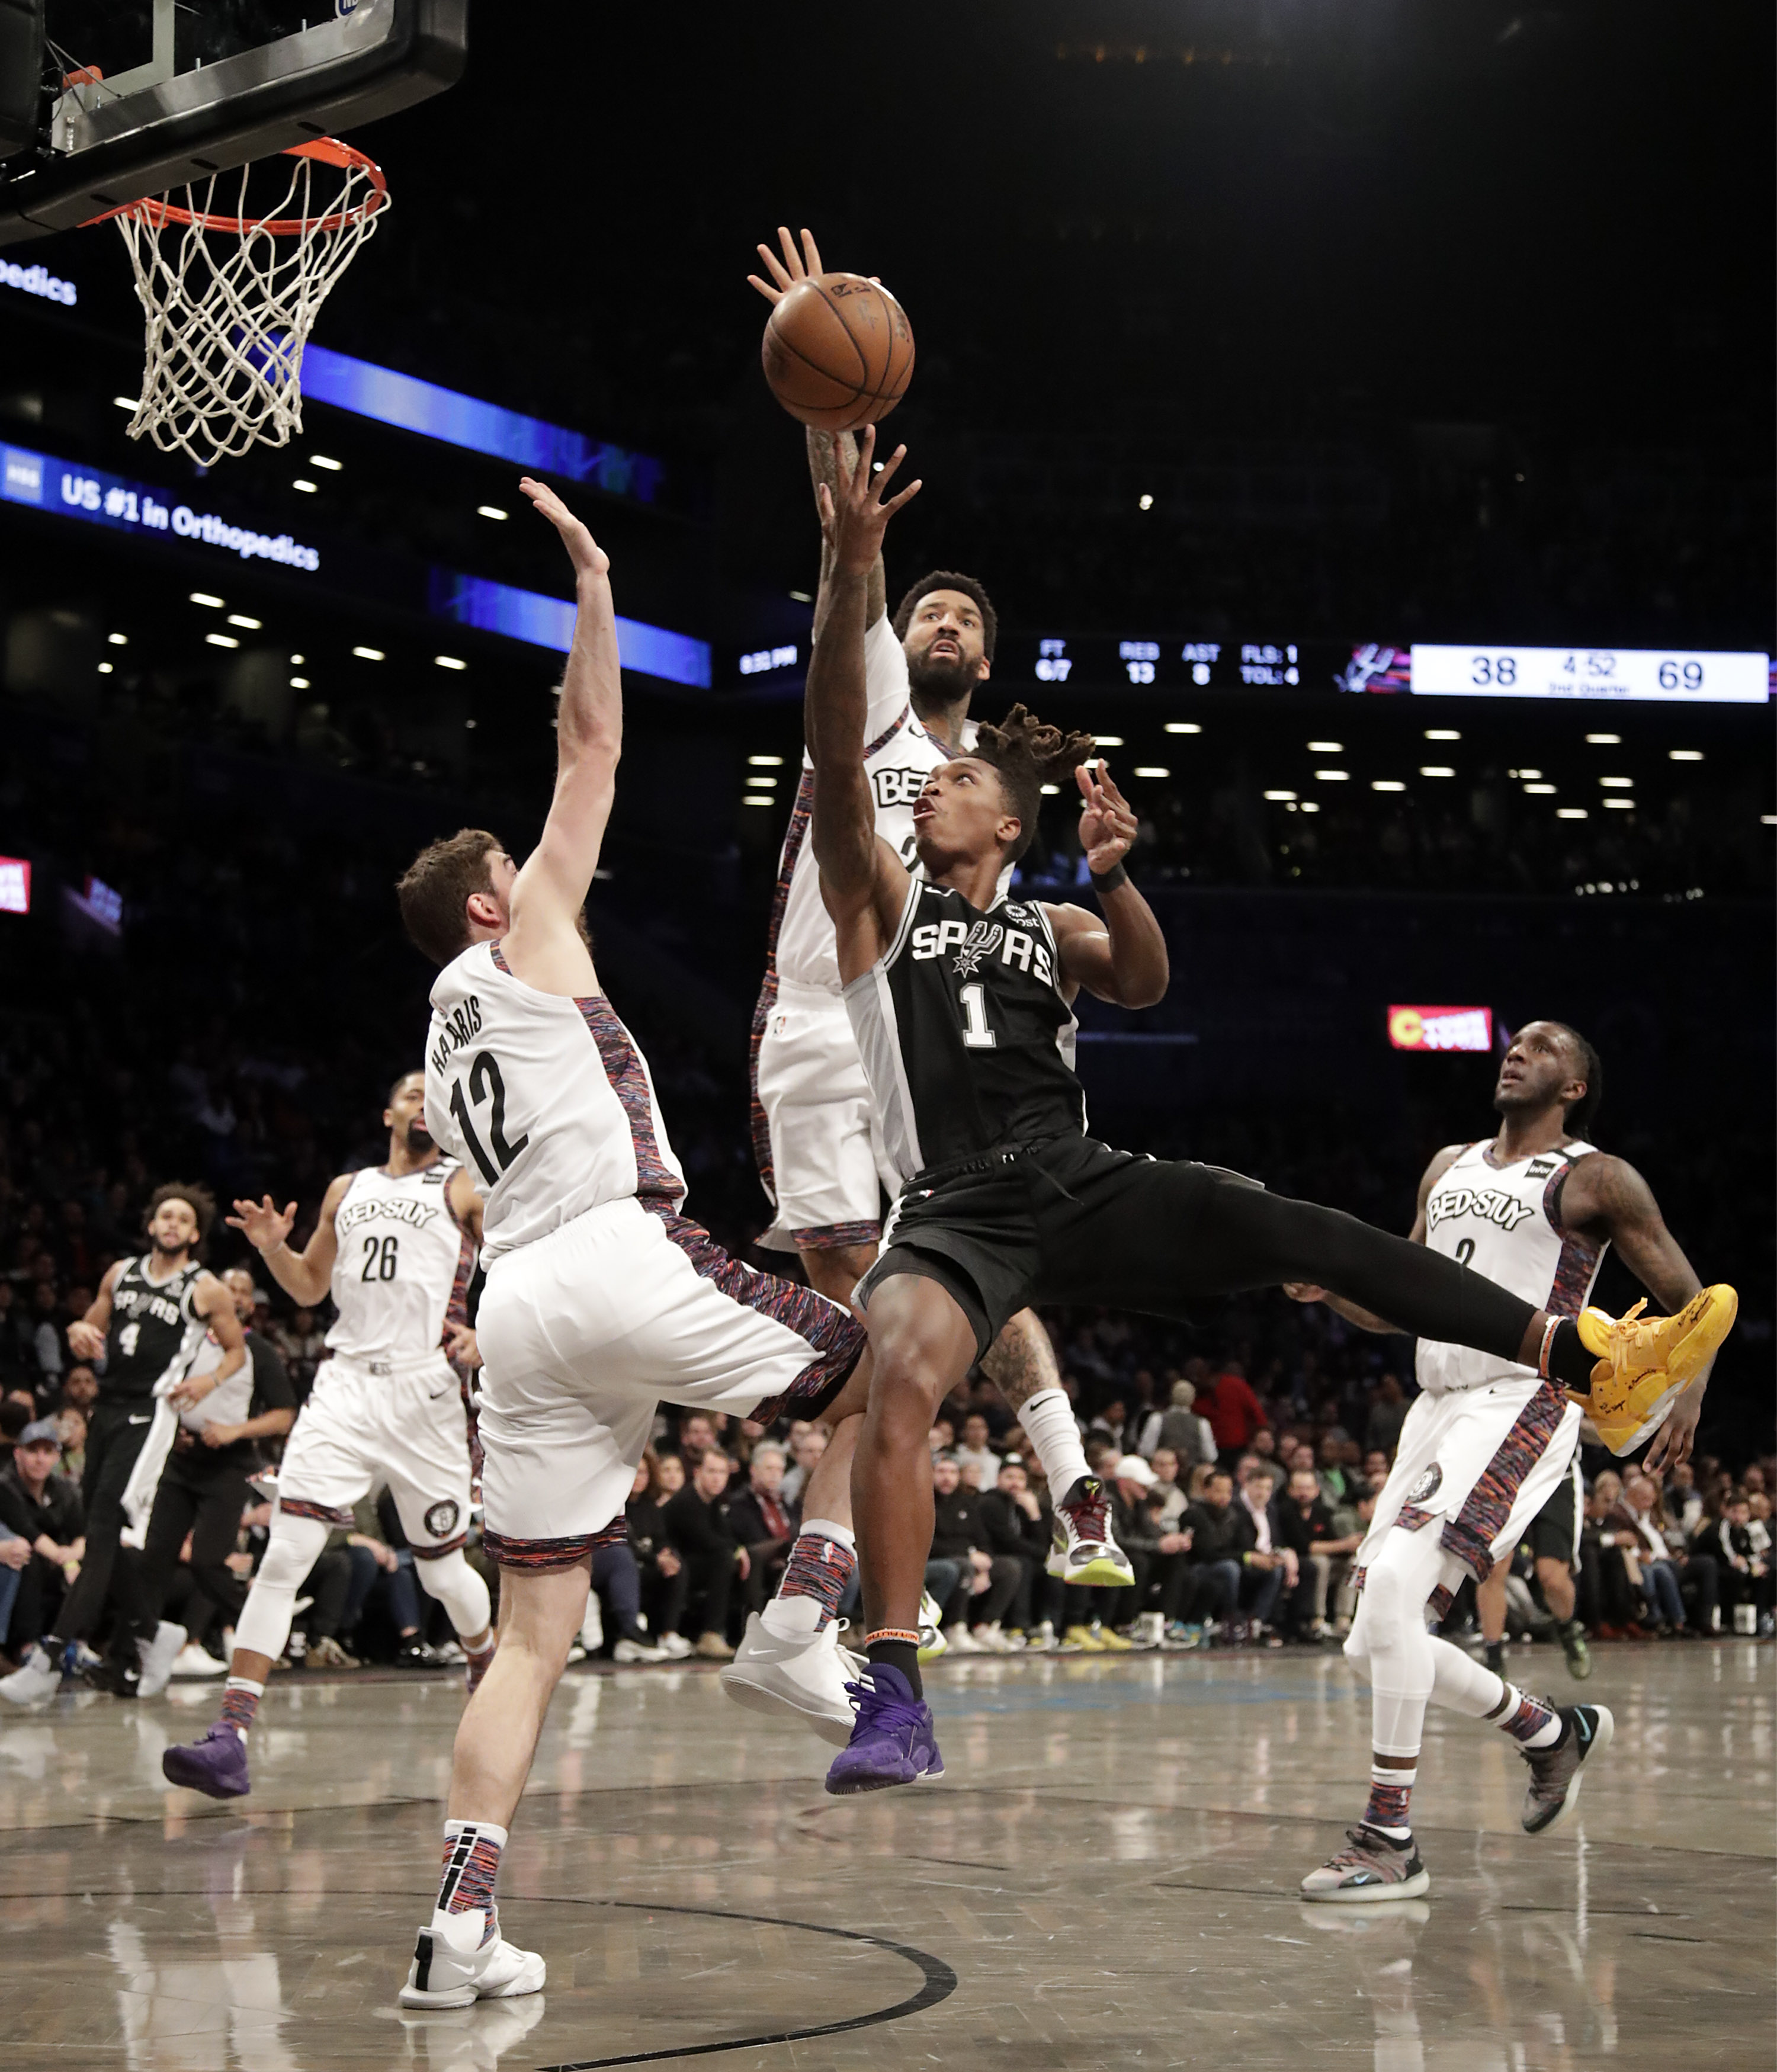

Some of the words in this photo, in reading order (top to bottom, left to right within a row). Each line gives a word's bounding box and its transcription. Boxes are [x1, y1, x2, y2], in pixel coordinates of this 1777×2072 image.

[61, 473, 101, 511] US
[104, 487, 140, 522] #1
[142, 496, 169, 530] in
[171, 505, 319, 571] Orthopedics
[771, 644, 797, 668] PM
[1040, 639, 1066, 658] FT
[1120, 641, 1160, 661] REB
[1182, 643, 1221, 663] AST
[1126, 661, 1155, 684] 13
[1284, 666, 1300, 685] 4
[1472, 656, 1516, 686] 38
[1659, 660, 1704, 691] 69
[873, 767, 929, 808] BE
[912, 920, 1053, 987] SPURS
[960, 982, 997, 1047] 1
[432, 995, 482, 1077] HARRIS
[449, 1051, 529, 1188] 12
[361, 1236, 398, 1282] 26
[118, 1322, 142, 1356] 4
